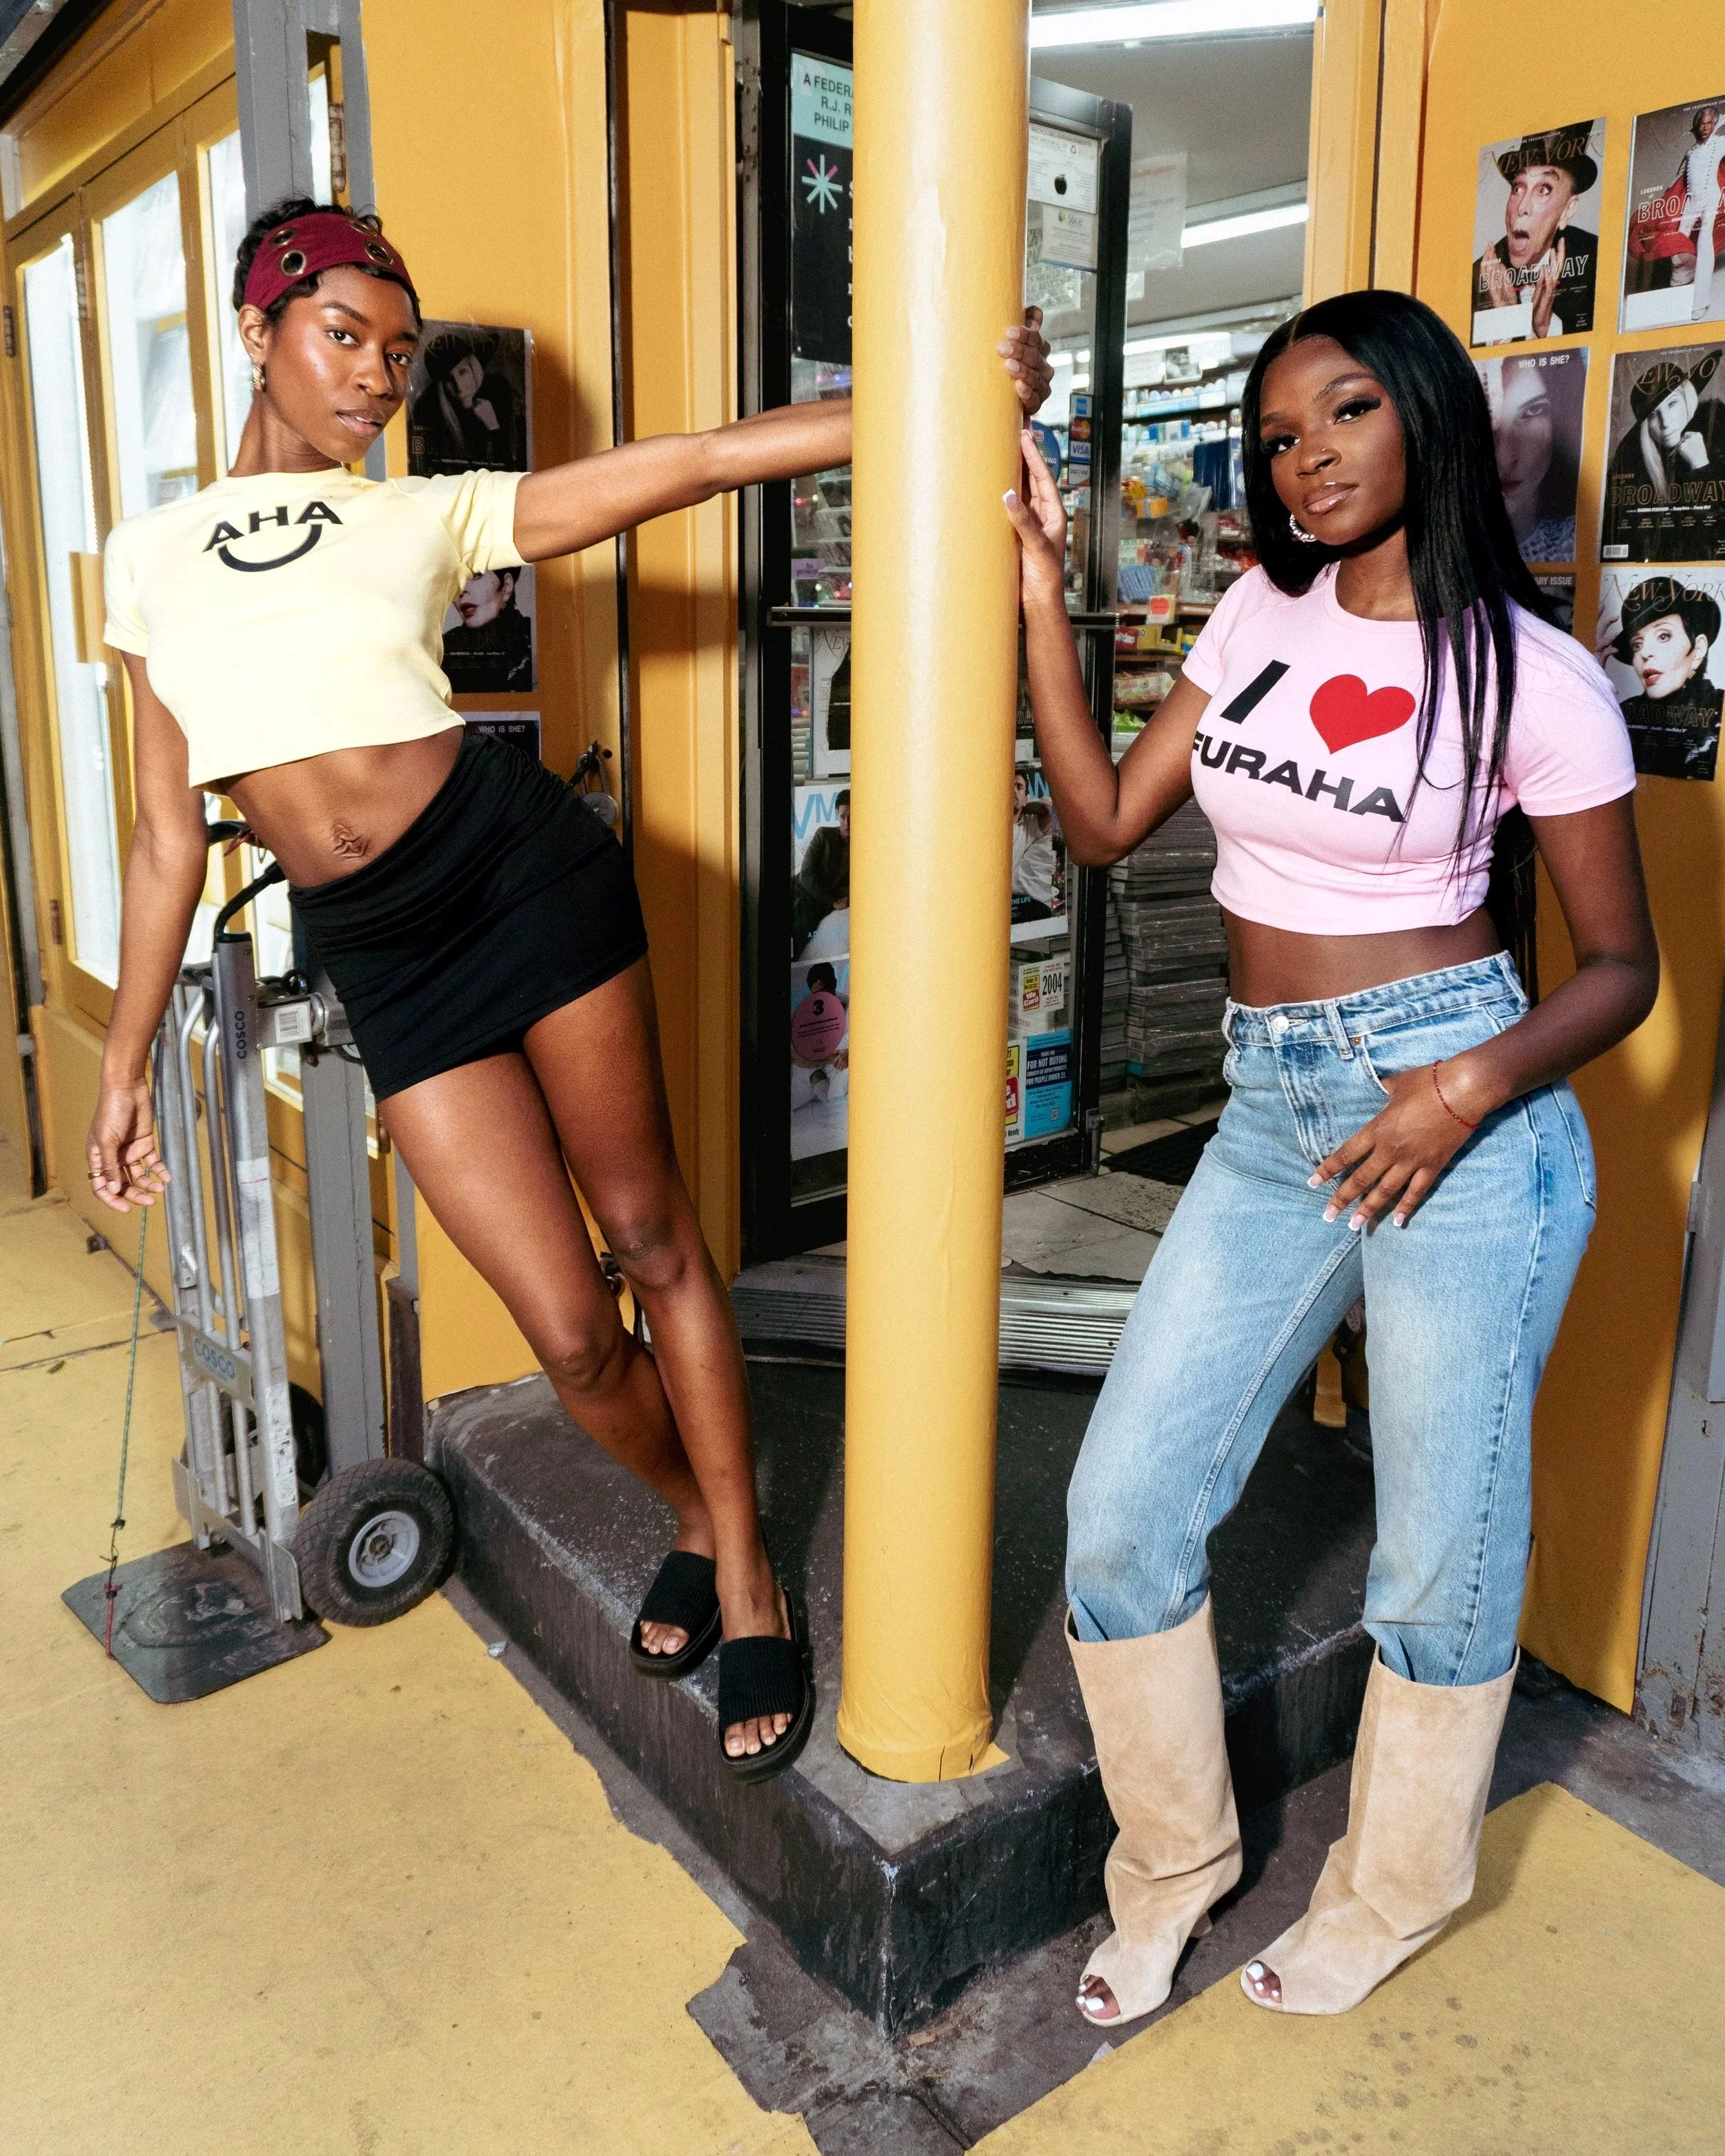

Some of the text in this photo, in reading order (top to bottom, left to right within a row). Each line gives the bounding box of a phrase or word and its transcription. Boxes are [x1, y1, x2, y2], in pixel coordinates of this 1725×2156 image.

[803, 72, 853, 98] A FEDER
[821, 96, 841, 112] R.J.
[814, 112, 849, 132] PHILIP
[1542, 133, 1604, 167] YORK
[1640, 185, 1663, 195] LEGENDS
[1479, 255, 1589, 293] BROADWAY
[1519, 355, 1570, 369] WHO IS SHE?
[1072, 444, 1090, 455] VISA
[202, 501, 344, 553] AHA
[1550, 576, 1573, 585] ISSUE
[1602, 574, 1663, 611] NEW
[1219, 659, 1291, 725] I
[498, 725, 505, 733] IS
[1042, 972, 1063, 995] 2004
[1023, 996, 1039, 1006] Card
[1026, 992, 1037, 1000] We
[813, 999, 825, 1016] 3
[235, 1010, 246, 1059] COSCO
[1027, 1054, 1067, 1070] FOR NOT BUYING
[1034, 1074, 1048, 1084] PEOPLE
[1048, 1072, 1061, 1081] UNDER
[1007, 1128, 1020, 1138] Ready
[194, 1337, 236, 1380] COSCO
